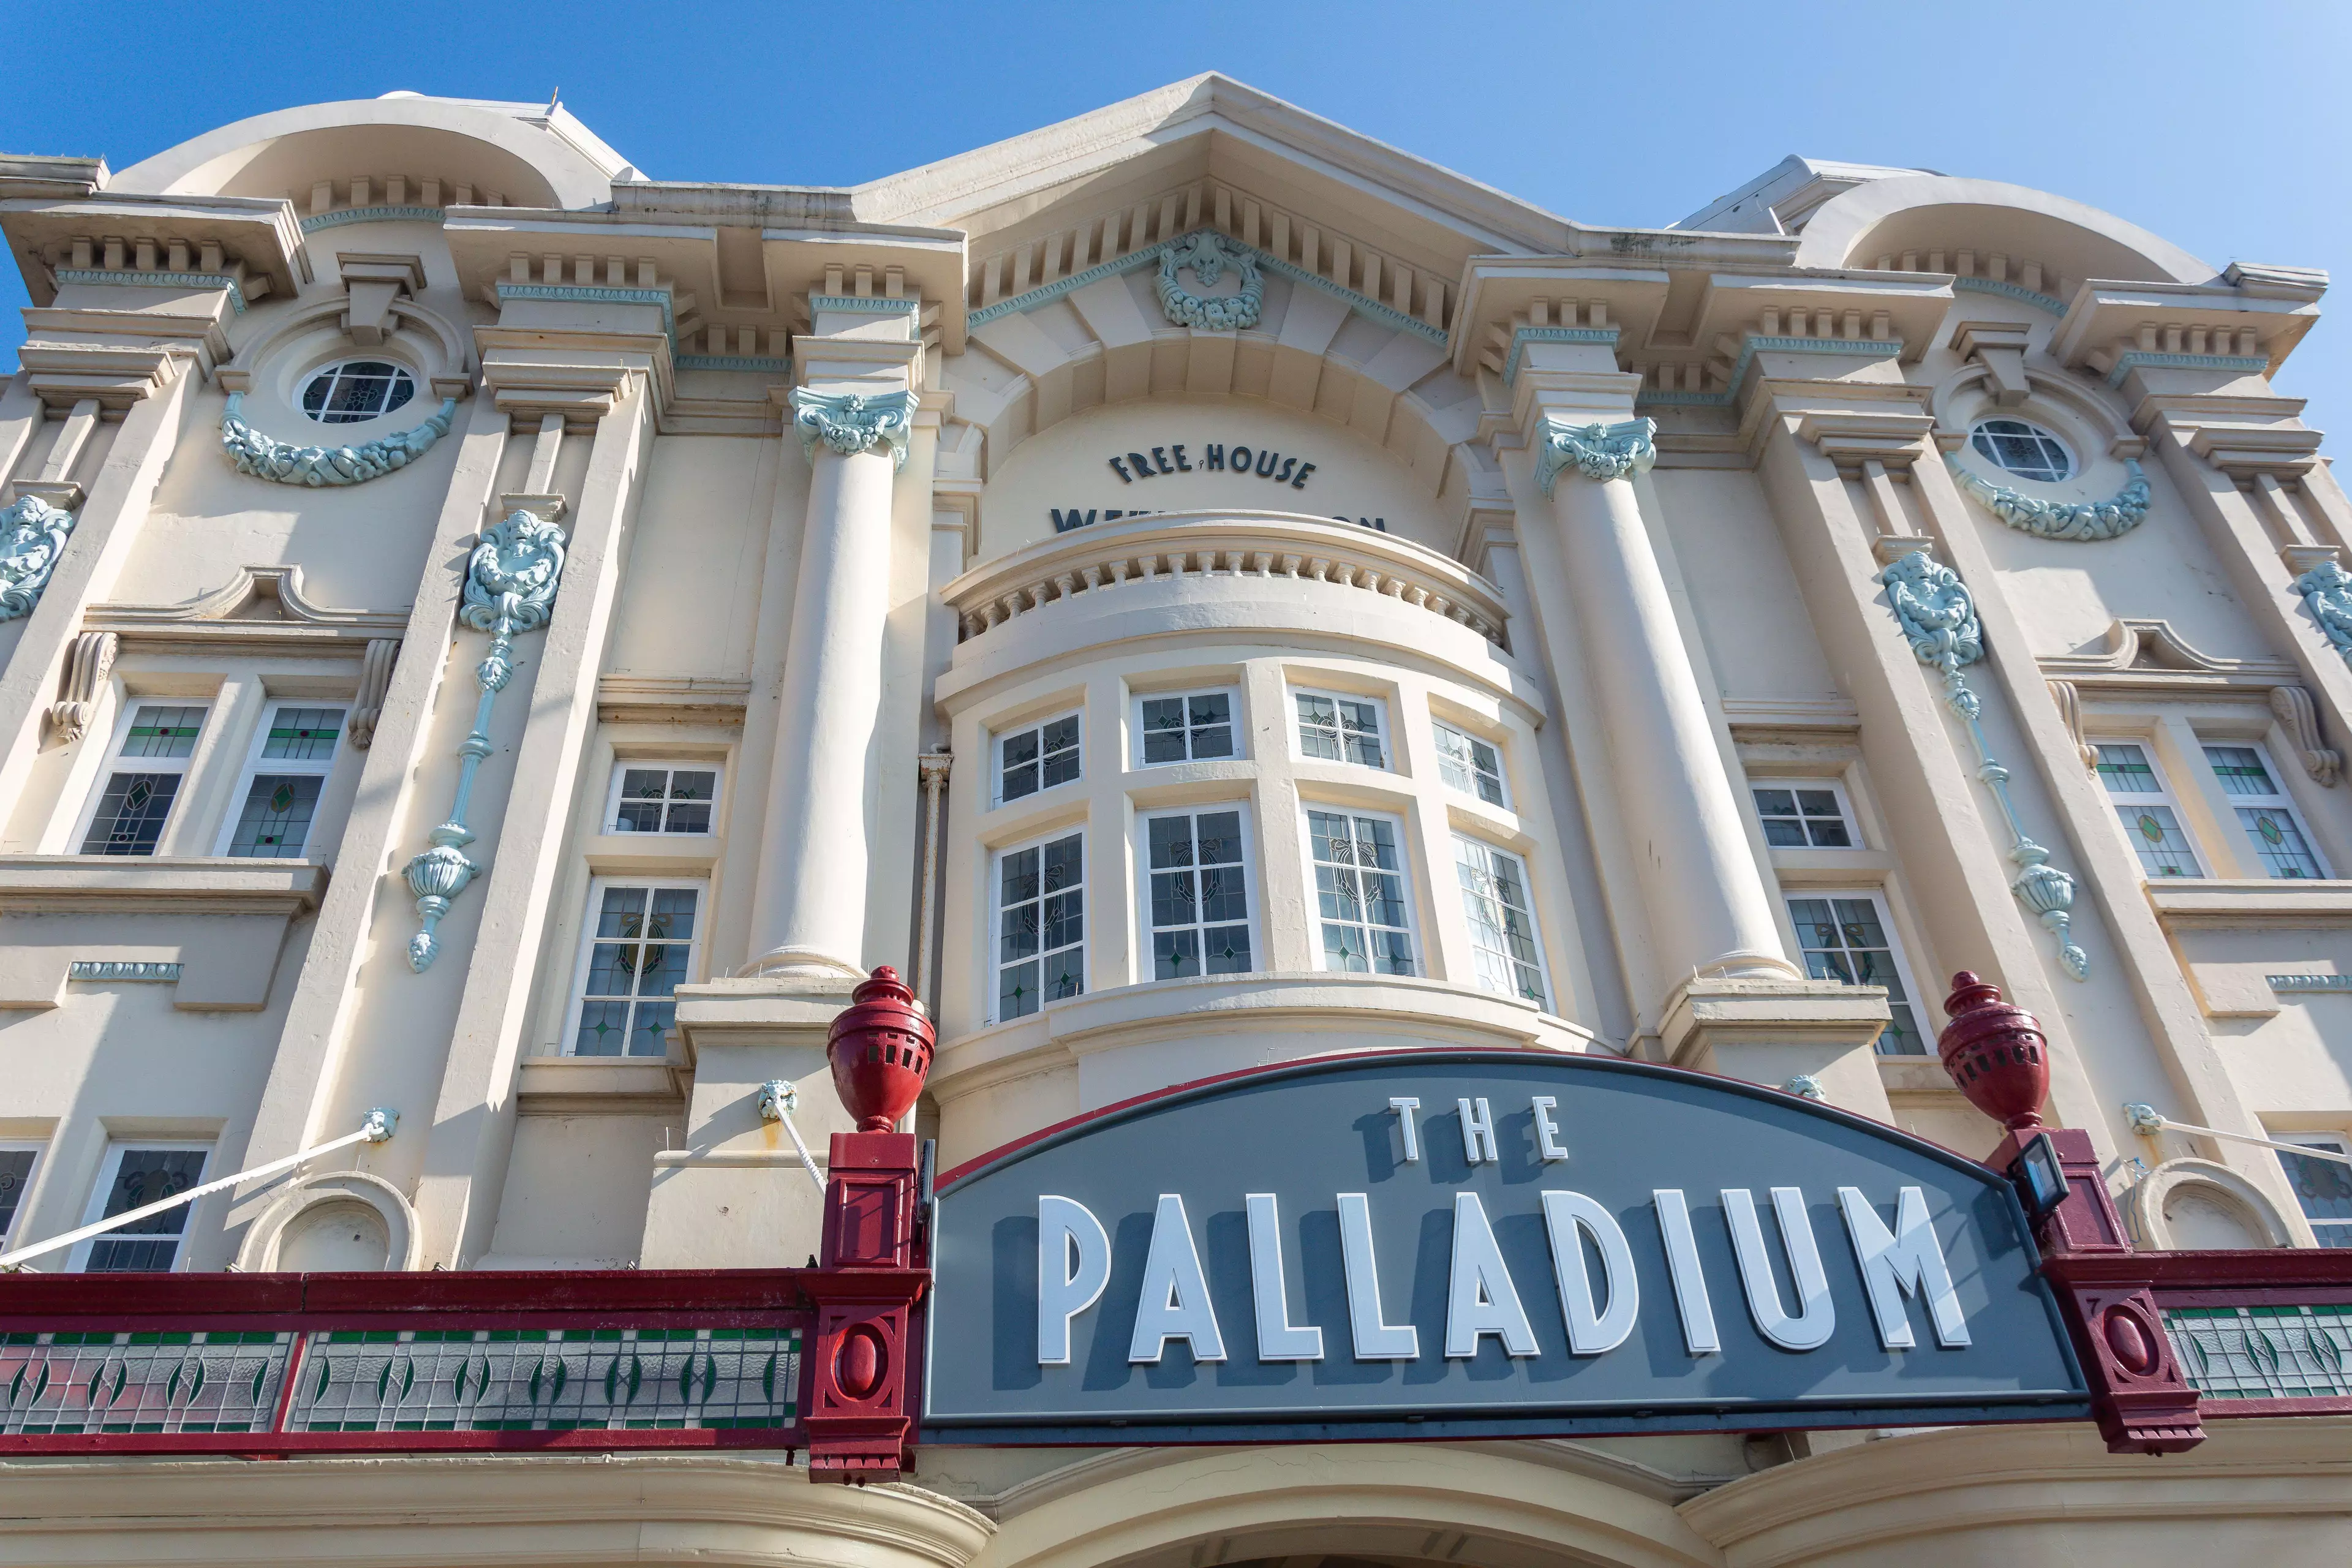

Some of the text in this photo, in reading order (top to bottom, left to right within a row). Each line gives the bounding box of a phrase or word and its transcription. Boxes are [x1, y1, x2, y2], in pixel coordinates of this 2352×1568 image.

[1109, 443, 1316, 488] FREE HOUSE
[1389, 1096, 1569, 1162] THE
[1038, 1186, 1972, 1365] PALLADIUM
